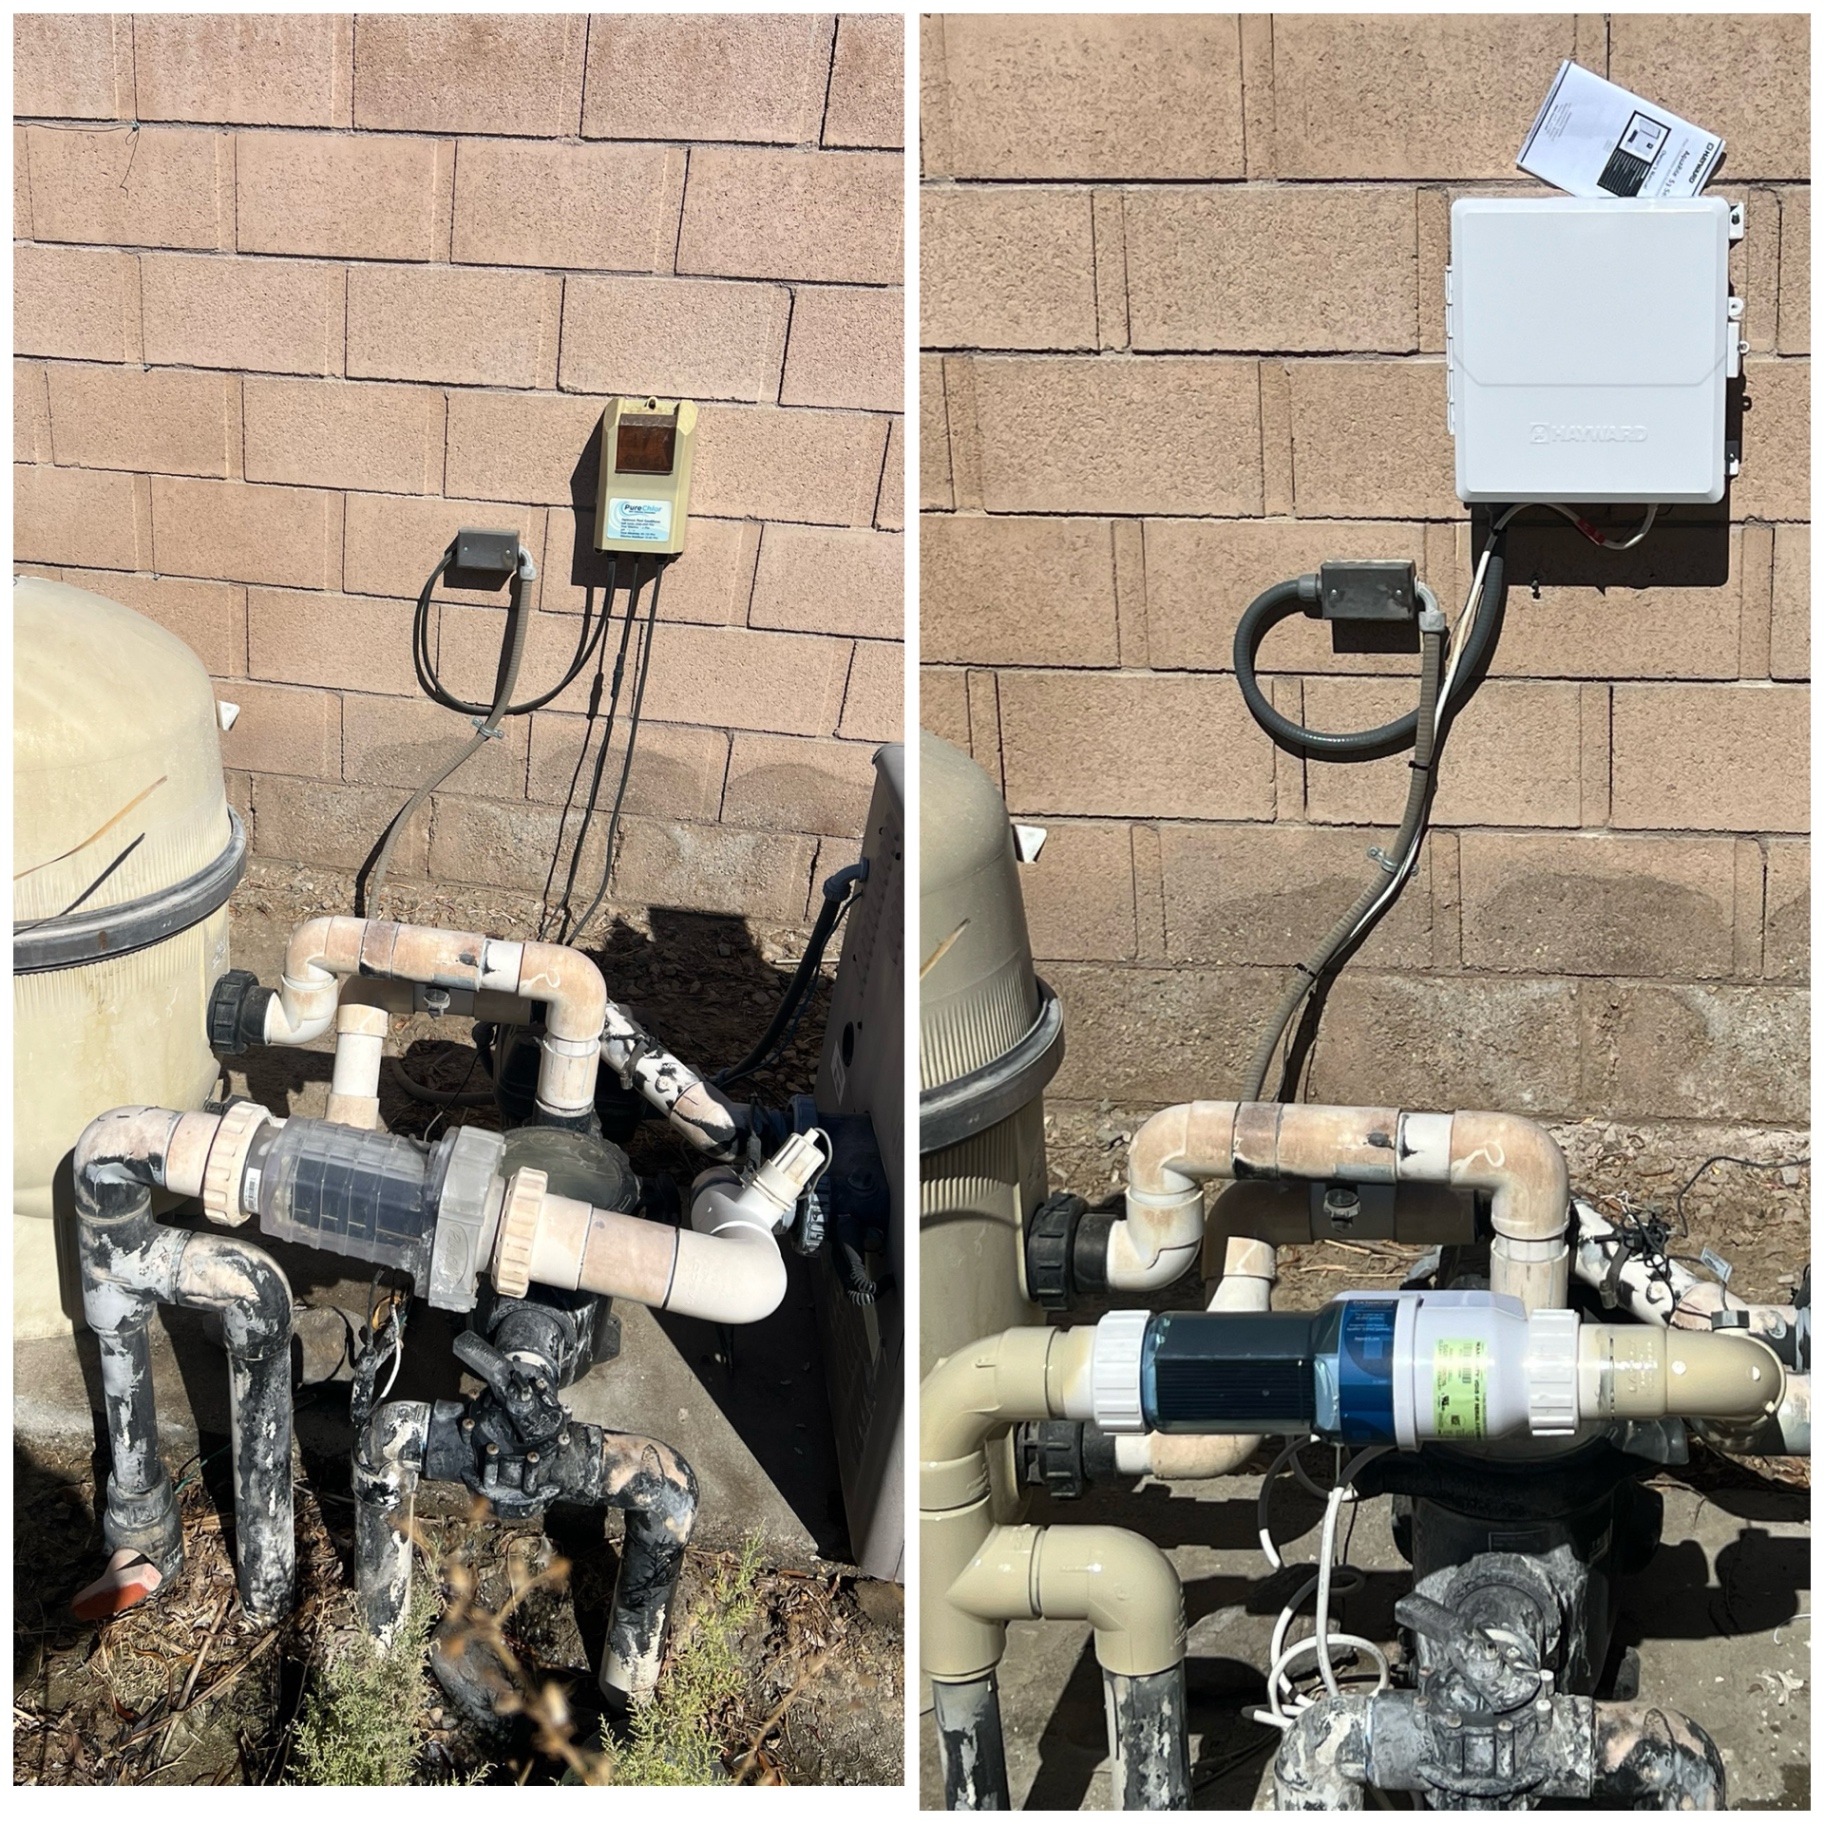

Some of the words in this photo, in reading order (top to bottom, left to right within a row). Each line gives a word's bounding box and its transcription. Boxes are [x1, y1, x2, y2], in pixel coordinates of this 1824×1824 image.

[1688, 150, 1711, 184] HAYWARD
[1551, 425, 1649, 442] HAYWARD
[624, 503, 662, 512] PureChlor
